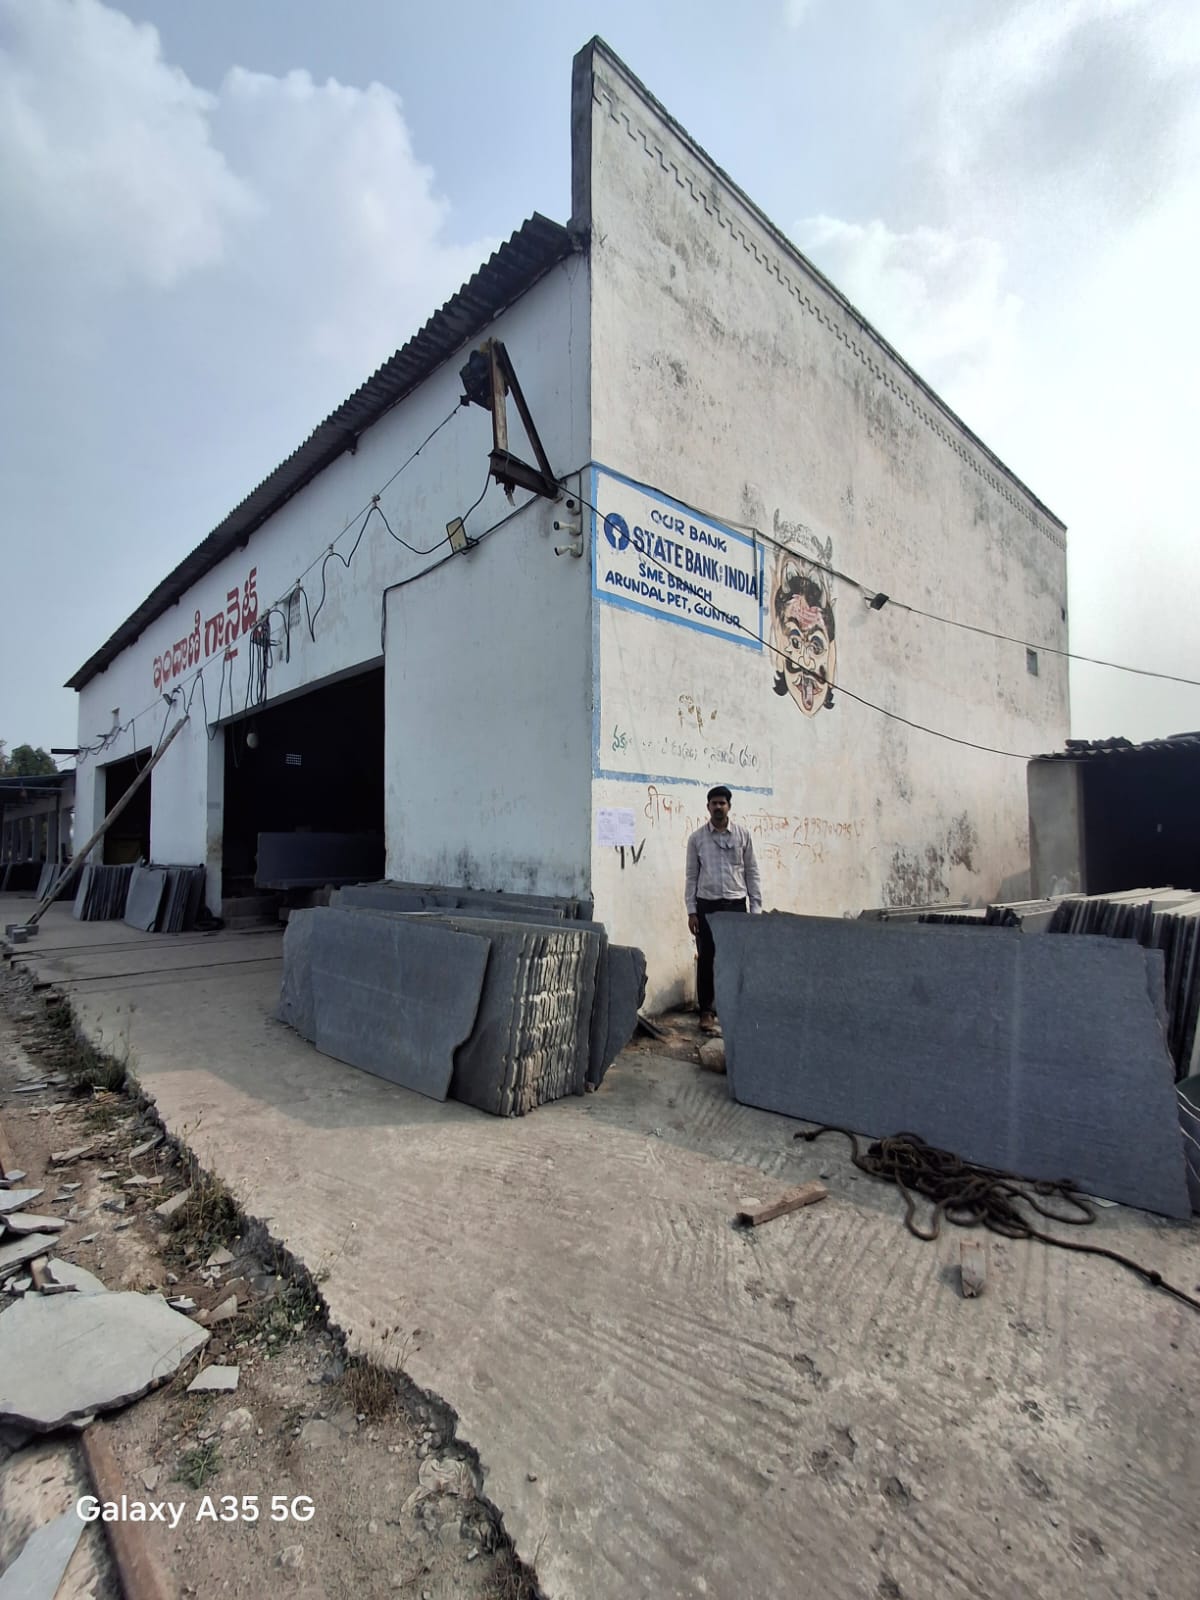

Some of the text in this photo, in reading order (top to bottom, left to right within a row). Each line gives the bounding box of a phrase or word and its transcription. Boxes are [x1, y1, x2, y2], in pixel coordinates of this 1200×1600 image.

[651, 509, 727, 553] OUR BANK
[633, 526, 683, 568] STATE
[685, 549, 719, 584] BANK
[724, 565, 757, 598] INDIA
[638, 562, 713, 602] SME BRANCH
[605, 570, 664, 603] ARUNDAL
[694, 602, 741, 628] GUNTUR
